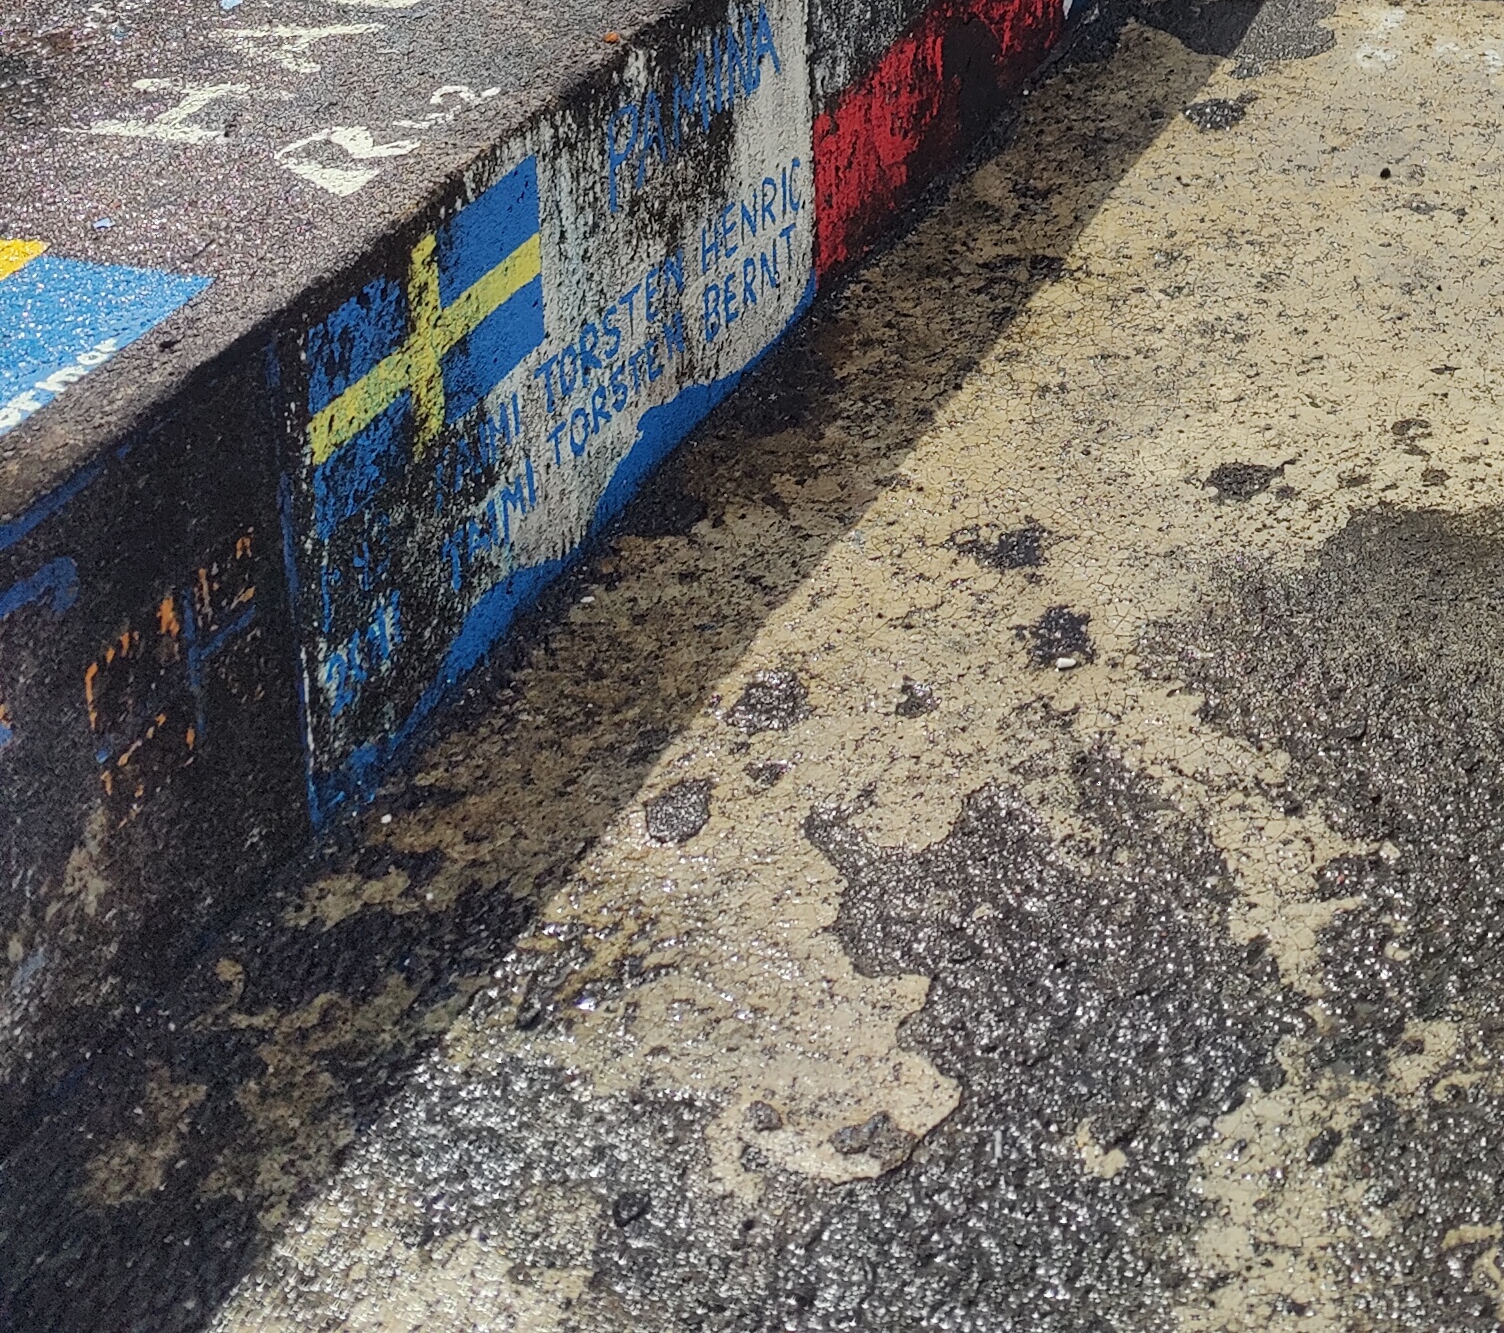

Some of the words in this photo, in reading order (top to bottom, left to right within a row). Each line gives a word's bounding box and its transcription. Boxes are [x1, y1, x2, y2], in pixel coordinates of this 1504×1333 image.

[607, 1, 781, 213] PAMINA
[534, 251, 683, 409] TORSTEN
[700, 157, 801, 271] HENRIC
[546, 313, 684, 467] TORSTEN
[702, 223, 800, 345] BERNT
